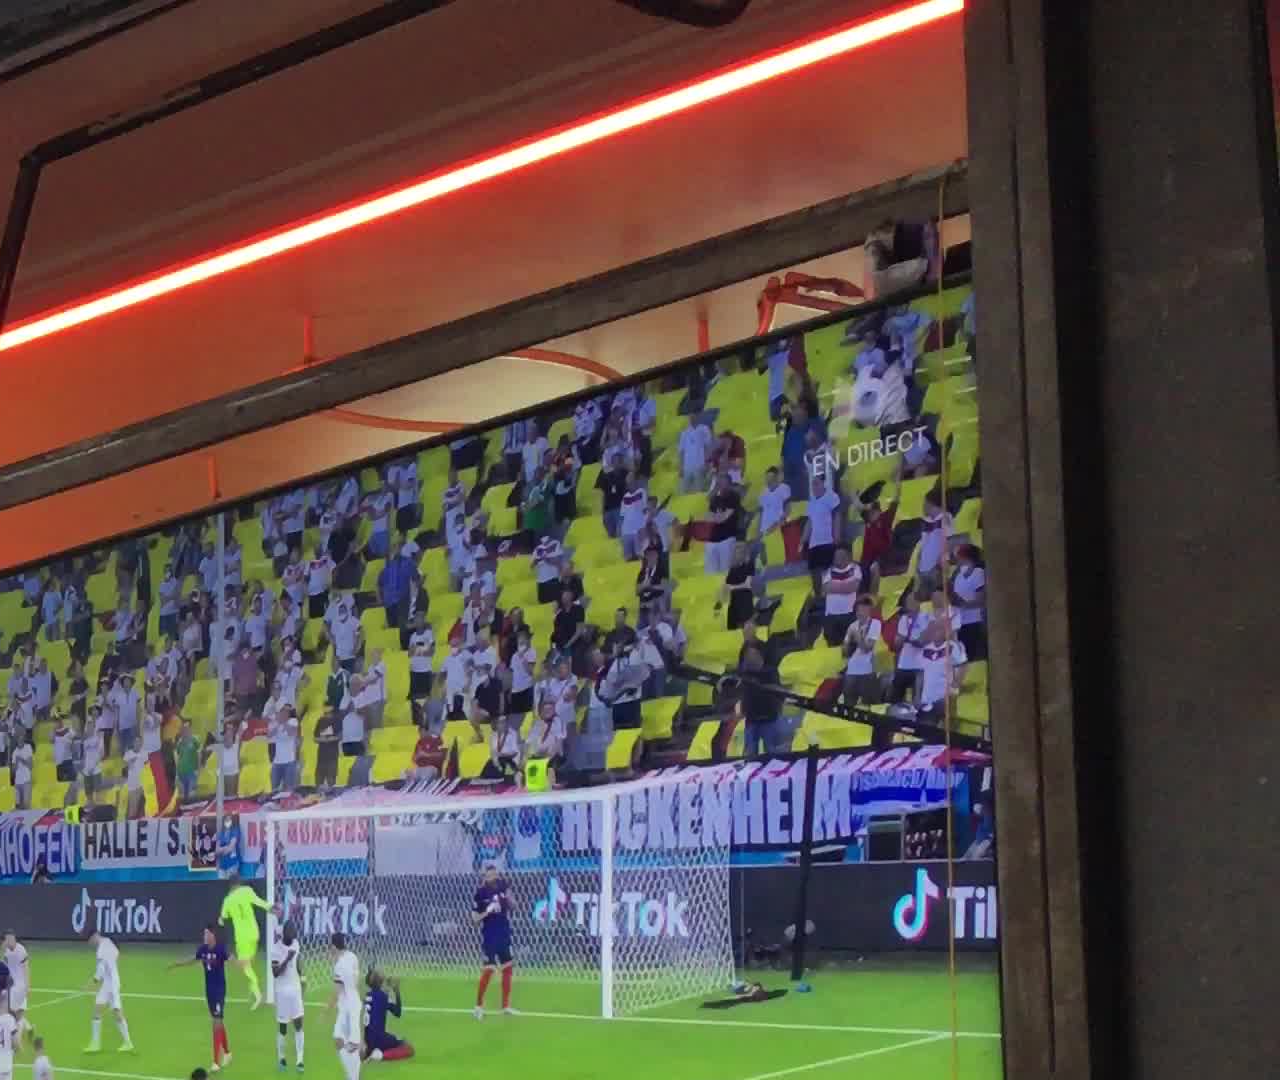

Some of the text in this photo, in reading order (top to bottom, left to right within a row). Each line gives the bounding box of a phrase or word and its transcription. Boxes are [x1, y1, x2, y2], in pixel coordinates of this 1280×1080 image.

[812, 425, 928, 476] EN DIRECT
[84, 821, 149, 862] HALLE
[94, 898, 163, 934] TikTok
[301, 895, 389, 936] TikTok
